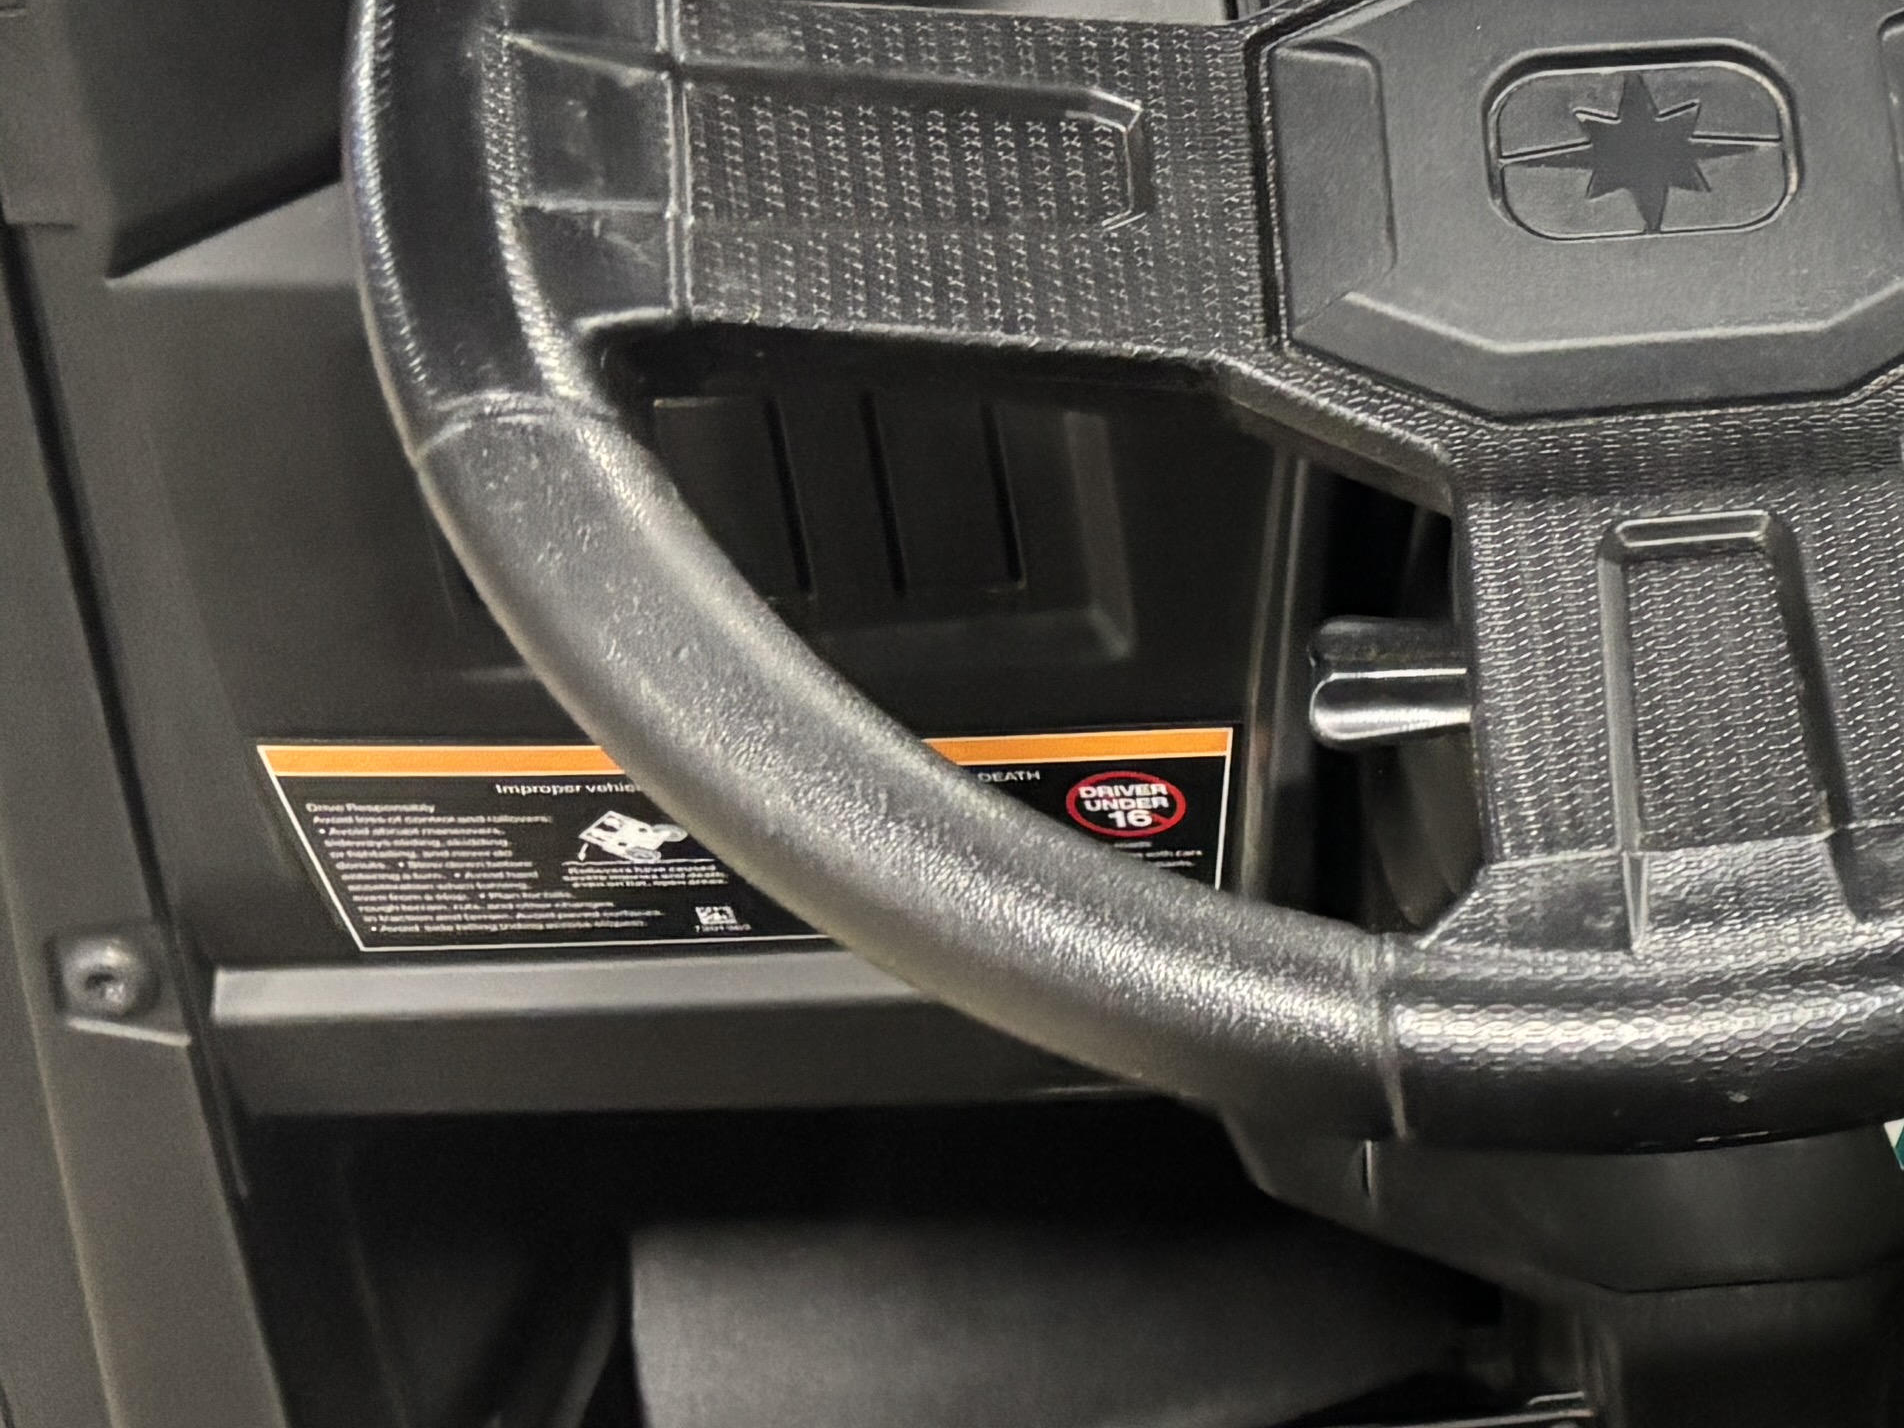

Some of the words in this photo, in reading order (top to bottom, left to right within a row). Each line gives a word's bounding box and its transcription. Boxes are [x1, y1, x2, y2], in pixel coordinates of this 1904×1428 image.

[494, 782, 582, 797] Improper
[584, 780, 641, 795] vehic
[977, 770, 1042, 784] DEATH
[1078, 783, 1169, 799] DRIVER
[1083, 796, 1170, 812] UNDER
[1106, 809, 1153, 829] 16
